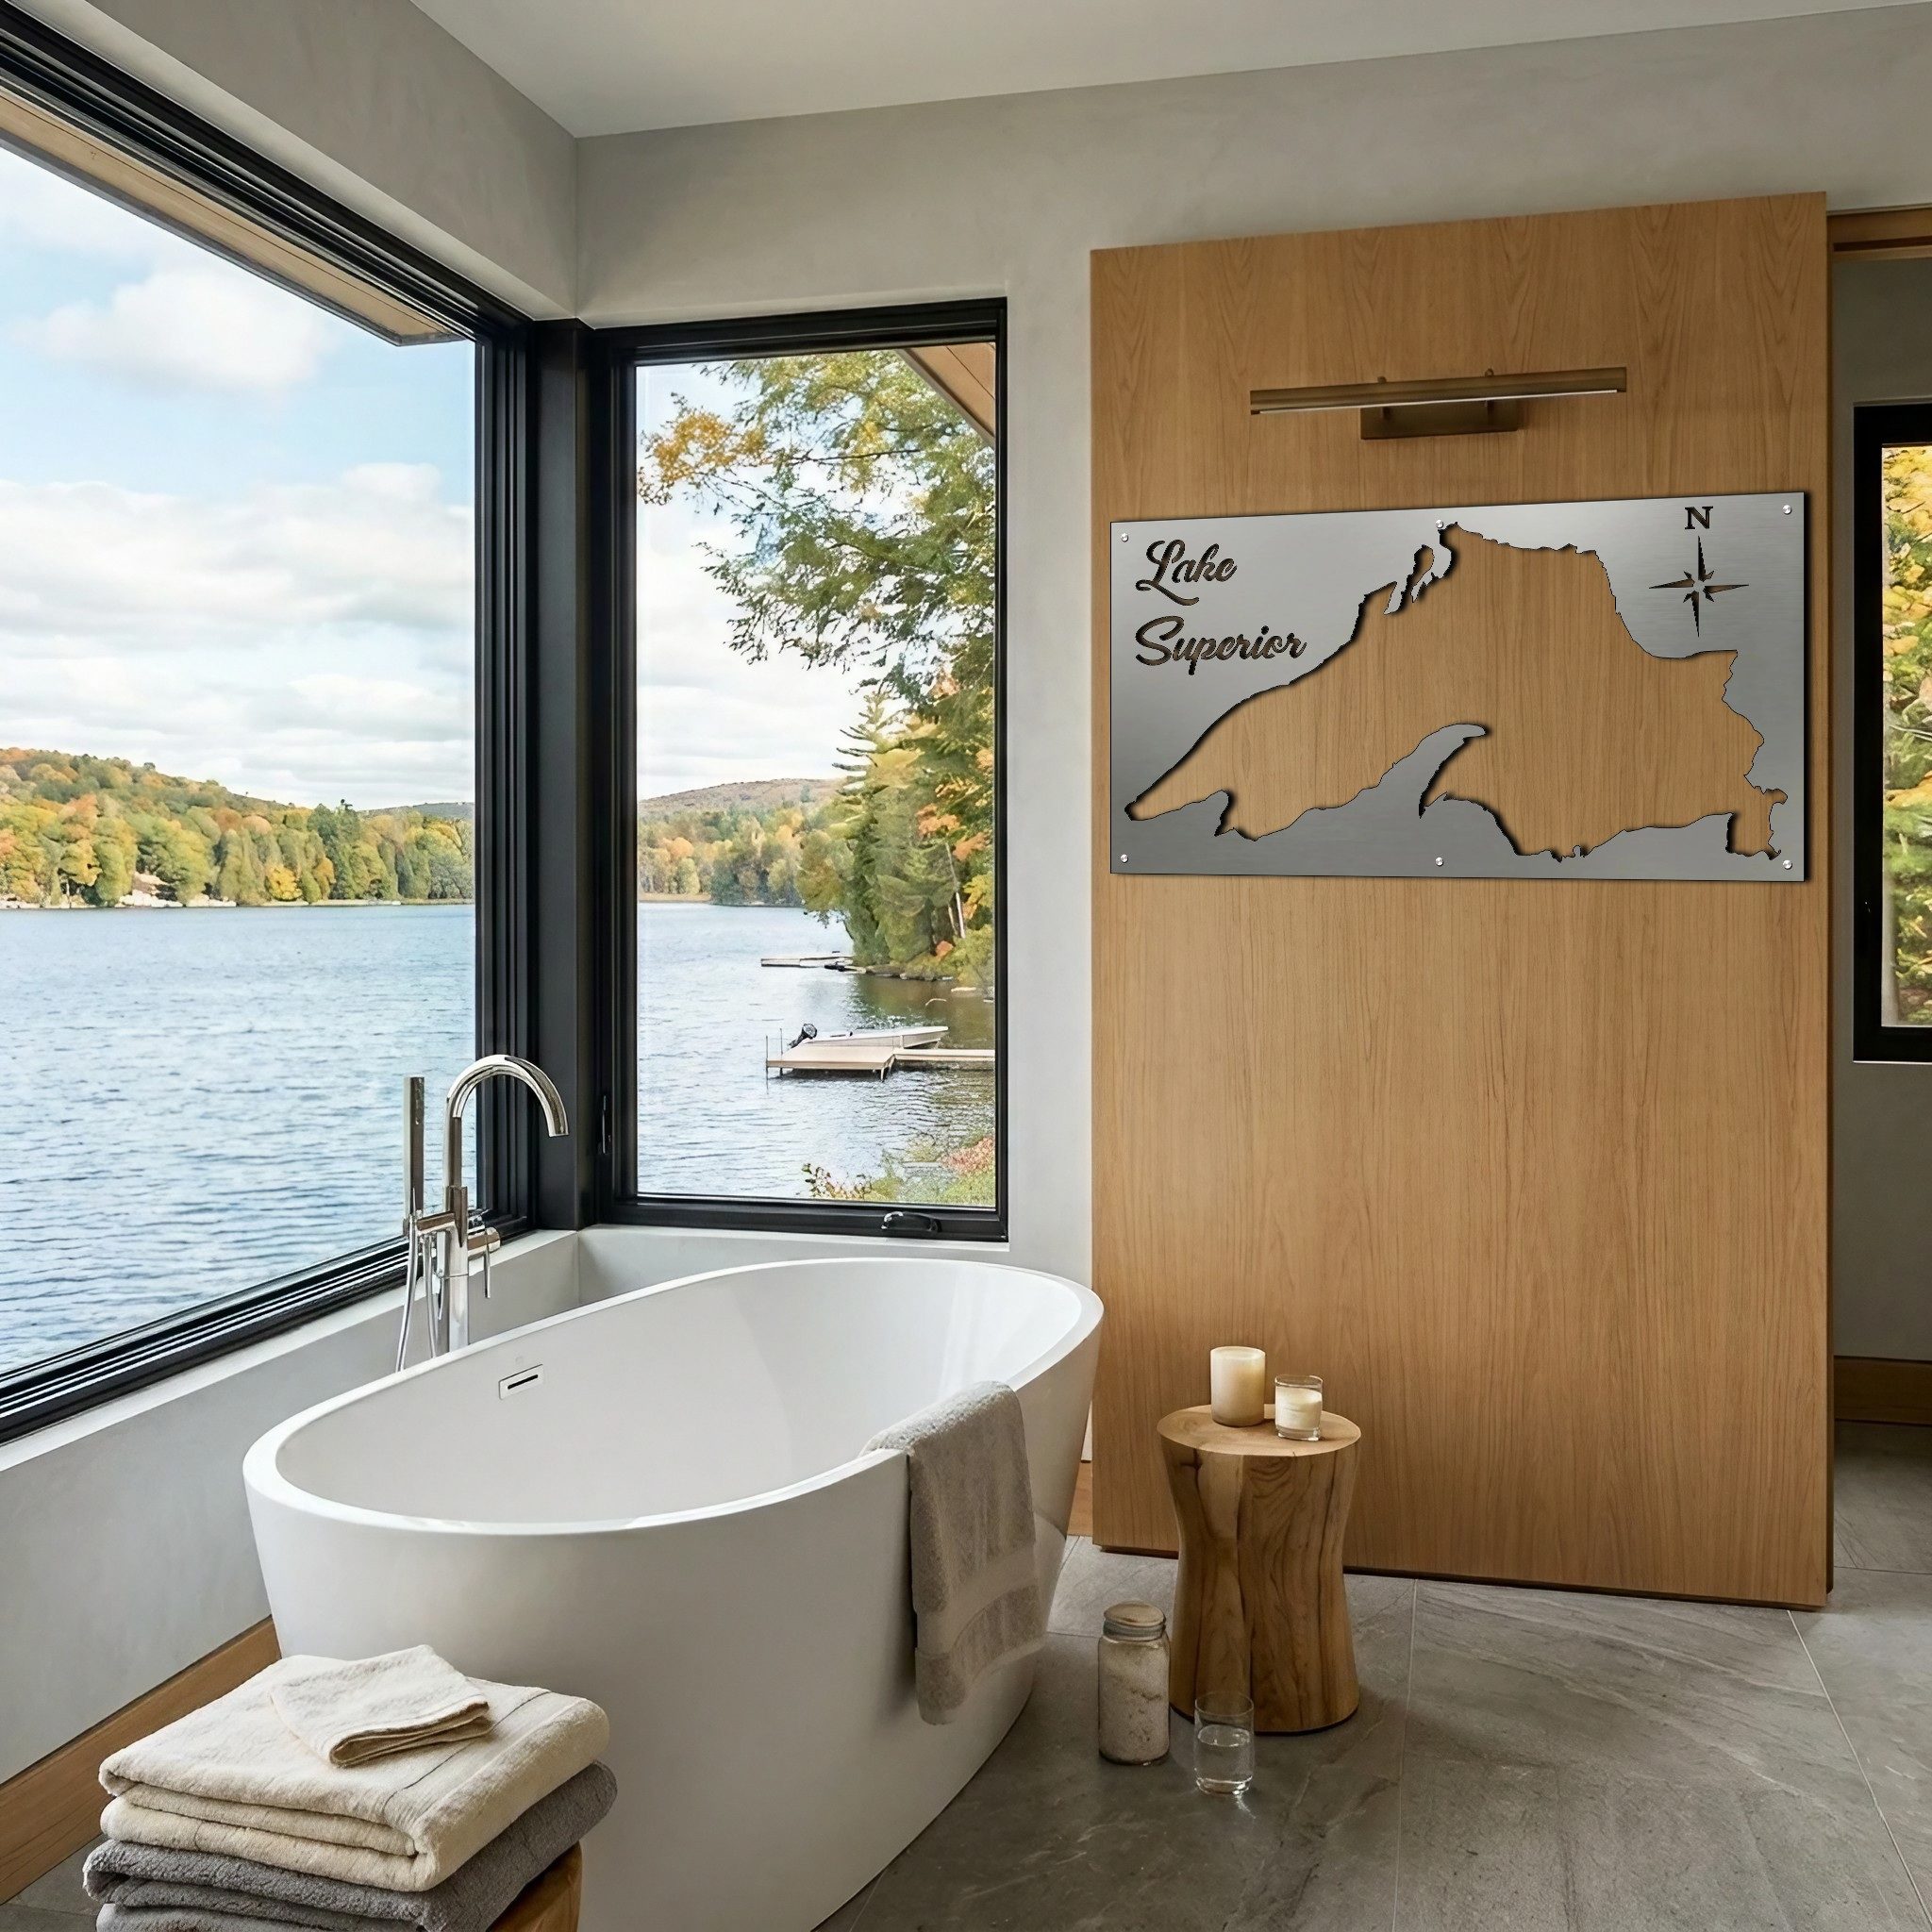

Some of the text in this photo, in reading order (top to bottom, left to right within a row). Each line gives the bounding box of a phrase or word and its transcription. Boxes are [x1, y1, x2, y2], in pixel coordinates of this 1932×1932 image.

[1684, 506, 1714, 530] N
[1135, 539, 1238, 607] Lake
[1135, 615, 1307, 676] Superior
